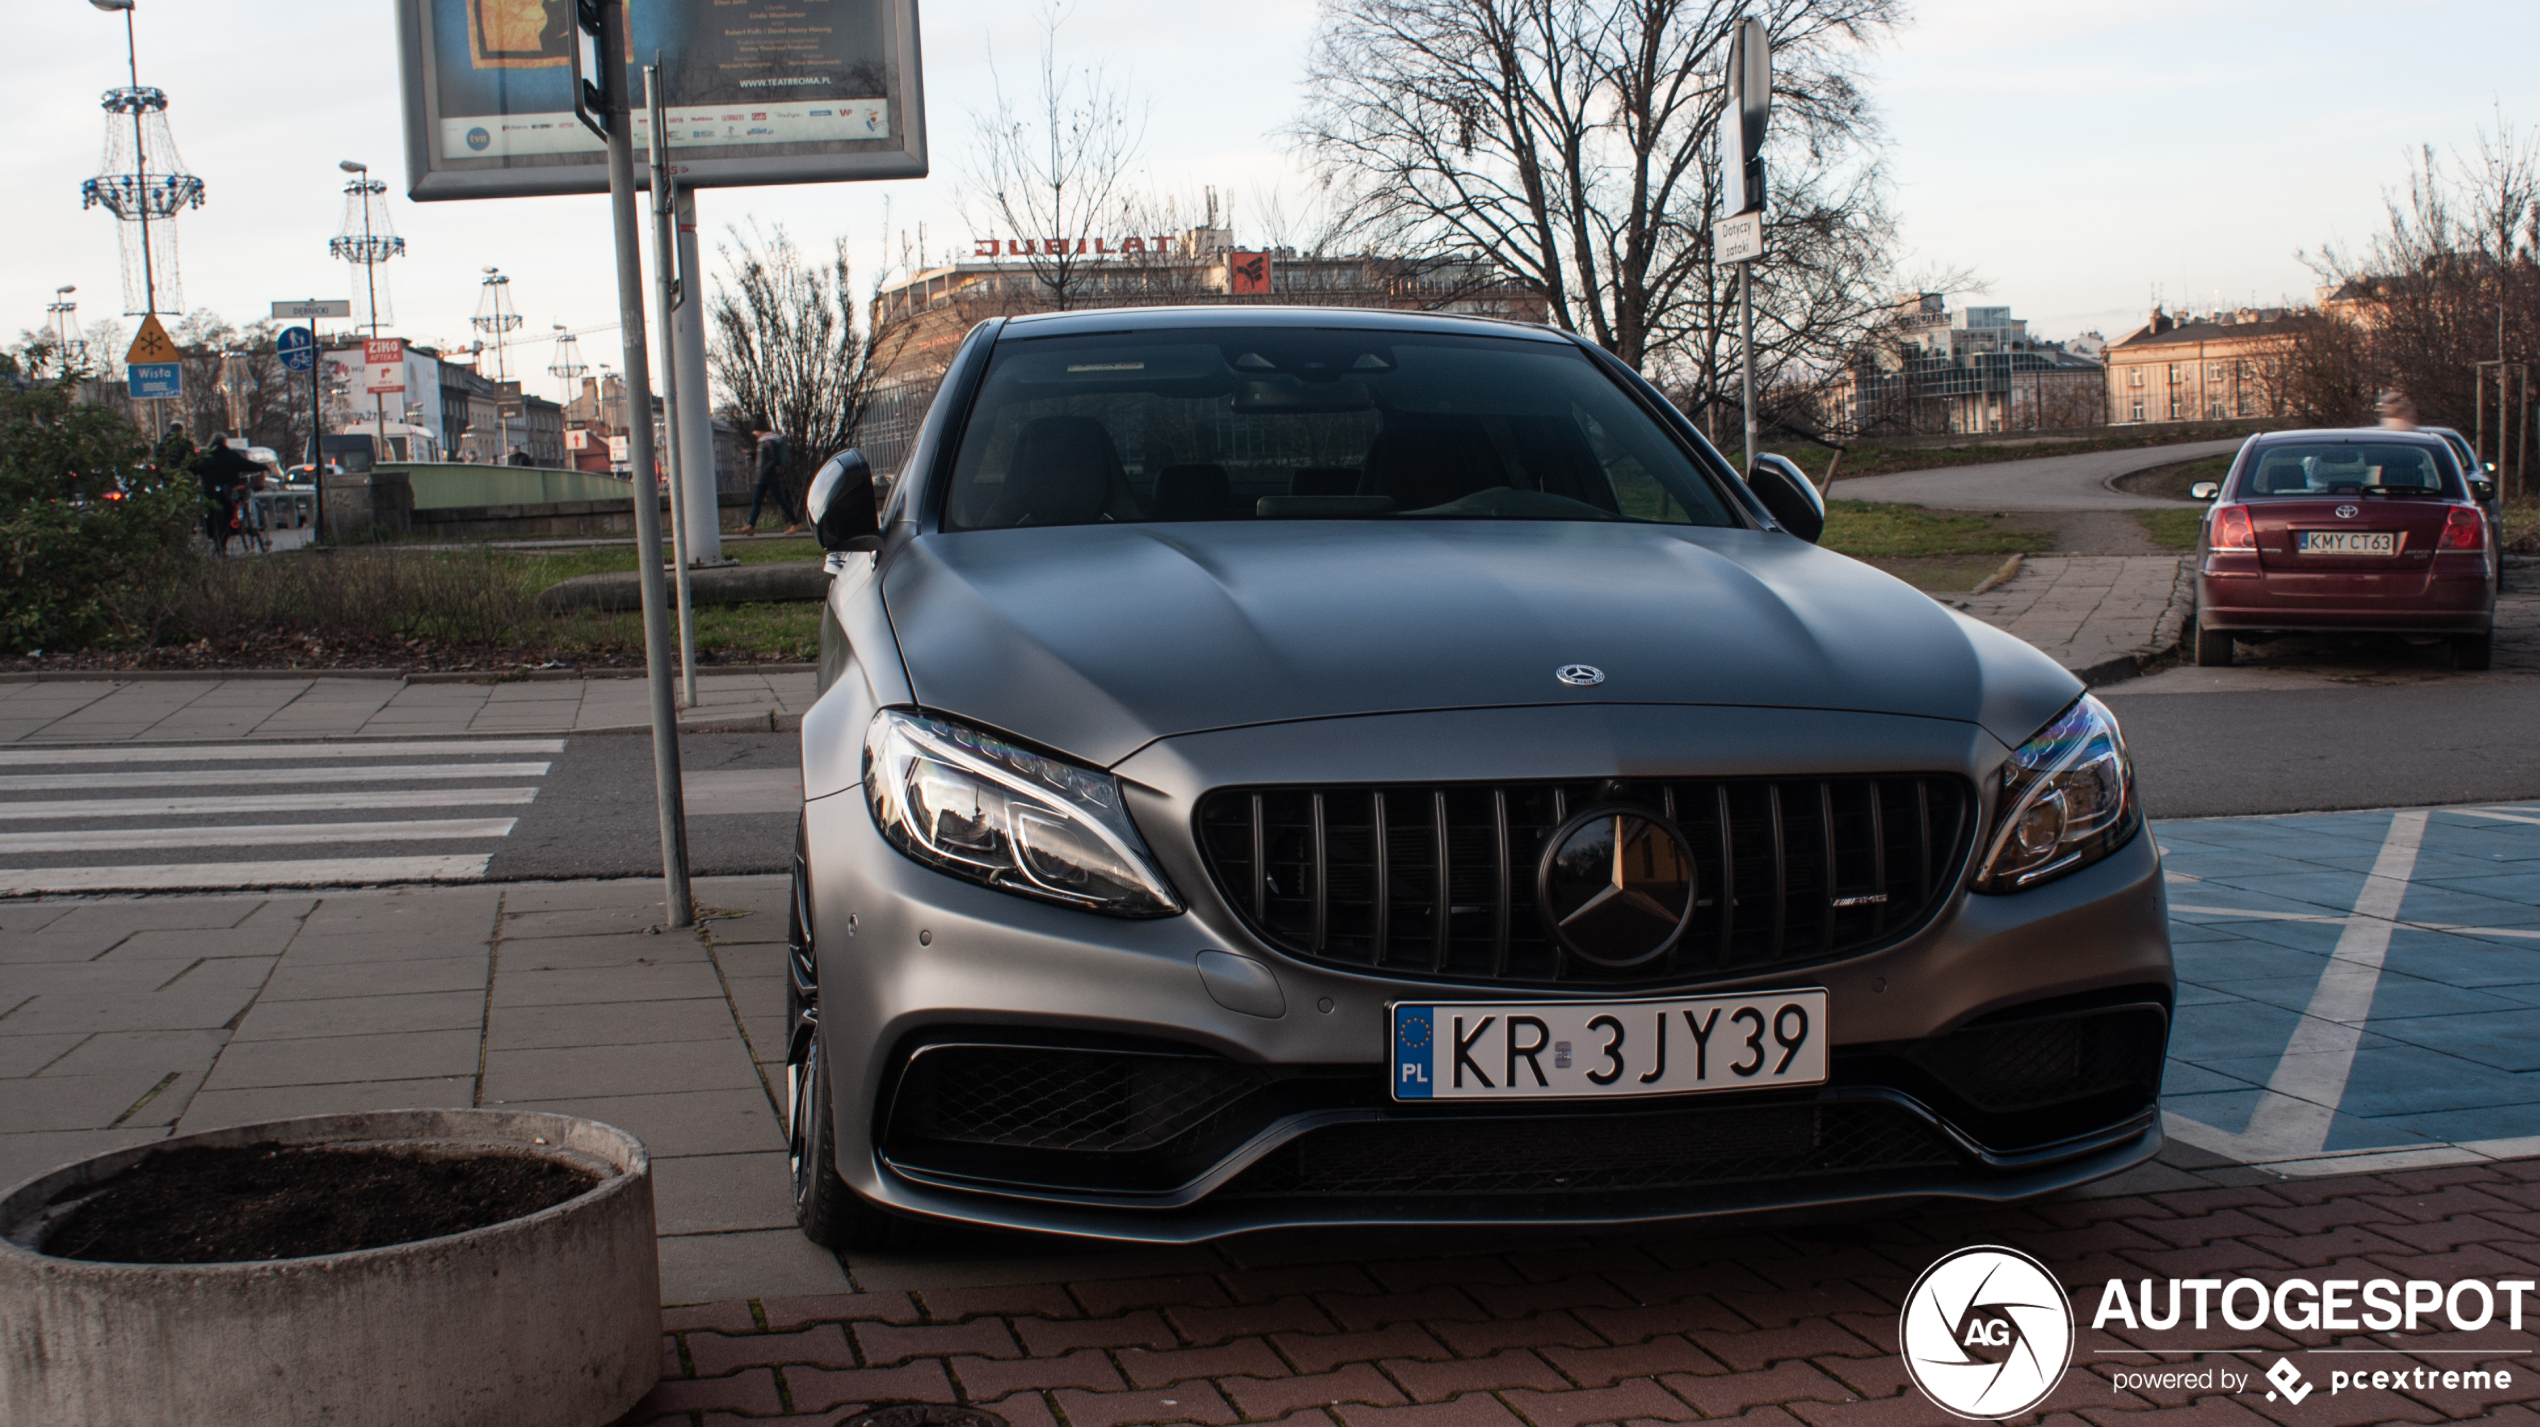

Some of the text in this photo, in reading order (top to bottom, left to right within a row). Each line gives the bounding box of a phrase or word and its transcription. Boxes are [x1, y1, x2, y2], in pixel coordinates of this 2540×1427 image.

[740, 77, 832, 88] WWW.TEATRROMA.PL
[469, 133, 487, 144] tvn
[1722, 220, 1752, 238] Dotyczy
[975, 236, 1176, 256] JUBILAT
[1725, 237, 1749, 258] zatoki
[369, 353, 399, 362] APTEKA
[138, 367, 172, 379] Wisła
[2310, 534, 2391, 550] KMY CT63
[1453, 1003, 1808, 1088] KR 3JY39
[1402, 1063, 1428, 1083] PL
